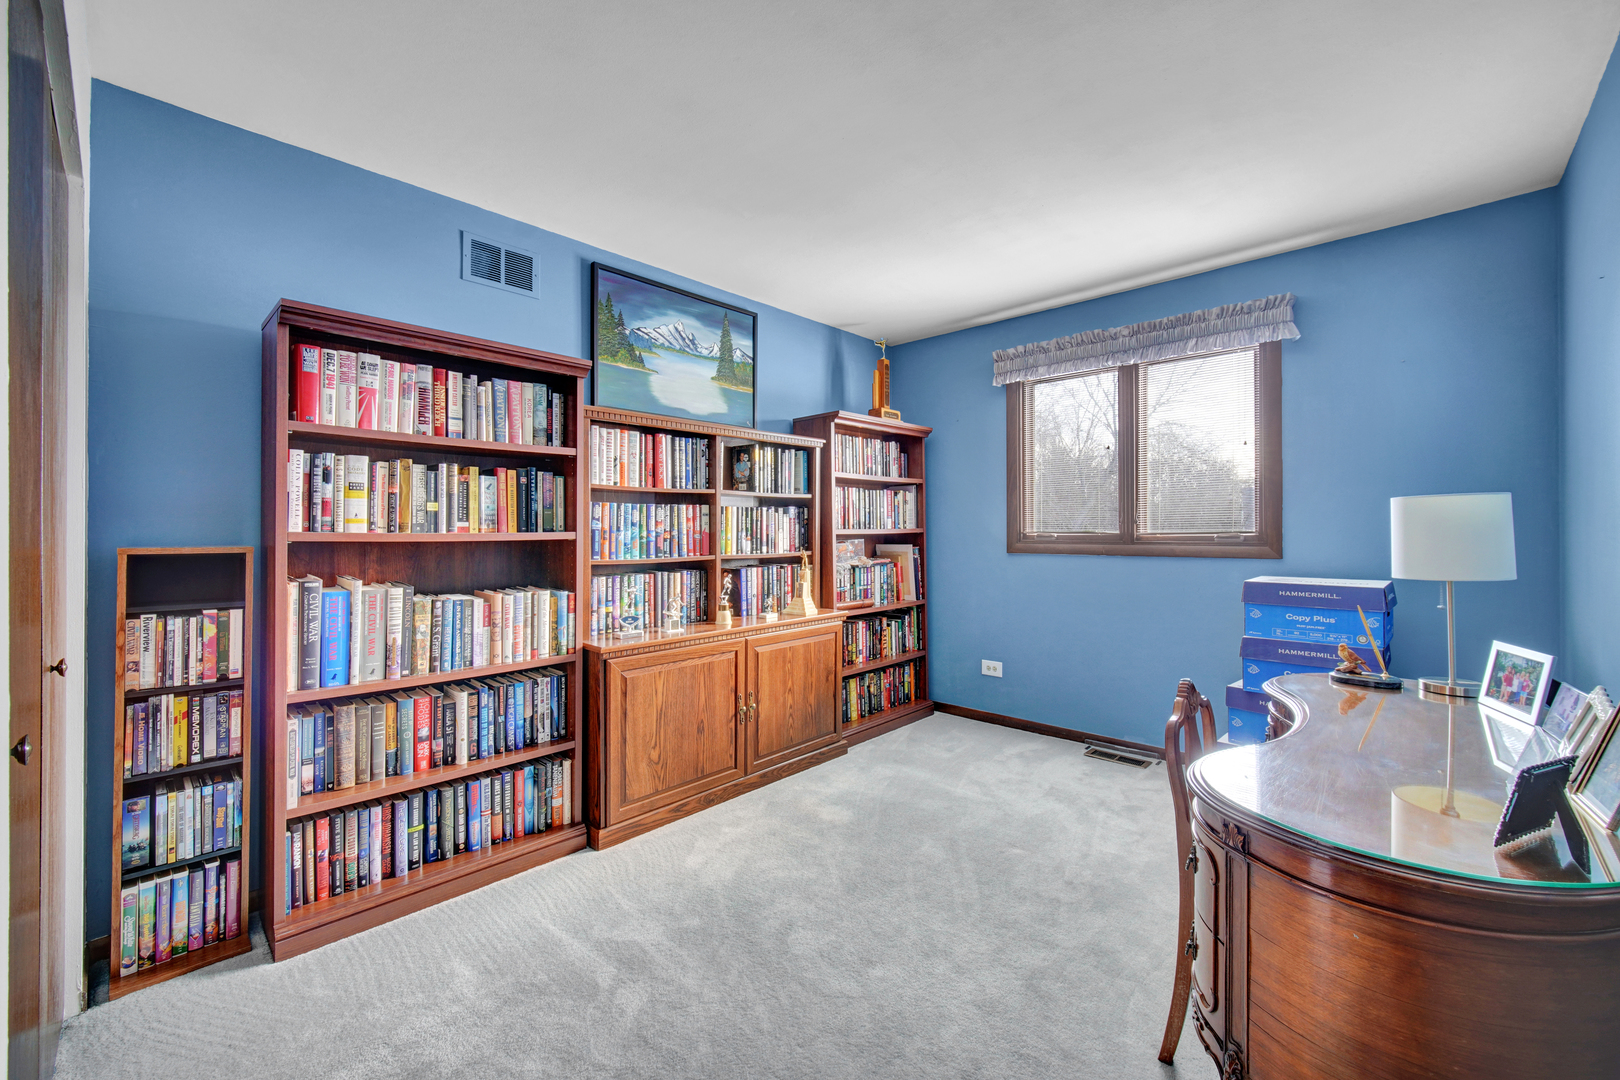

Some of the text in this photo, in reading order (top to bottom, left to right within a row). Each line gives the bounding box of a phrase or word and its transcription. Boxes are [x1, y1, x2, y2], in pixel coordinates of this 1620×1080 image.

[339, 370, 350, 384] WON
[418, 387, 431, 425] HIMMLER
[496, 391, 505, 428] PATTON
[512, 394, 520, 429] PATTON
[417, 472, 425, 524] HEISENBERG'S WAR
[142, 616, 154, 653] Riverview
[309, 593, 319, 643] CIVIL WAR
[328, 596, 338, 661] THE CIVIL WAR
[368, 594, 376, 656] THE CIVIL WAR
[432, 617, 441, 625] U.
[1285, 613, 1336, 624] Copy Plus
[126, 621, 136, 656] CIVIL WAR
[432, 635, 441, 657] Grant
[514, 624, 522, 654] CIVIL WAR
[137, 721, 146, 766] HOME VIDEO
[215, 806, 226, 818] Slap
[382, 806, 392, 854] IRIS JOHANSEN
[347, 862, 356, 880] CUBA
[124, 915, 136, 932] Snow
[175, 900, 186, 924] DUMBO
[190, 901, 204, 927] FANTASIA
